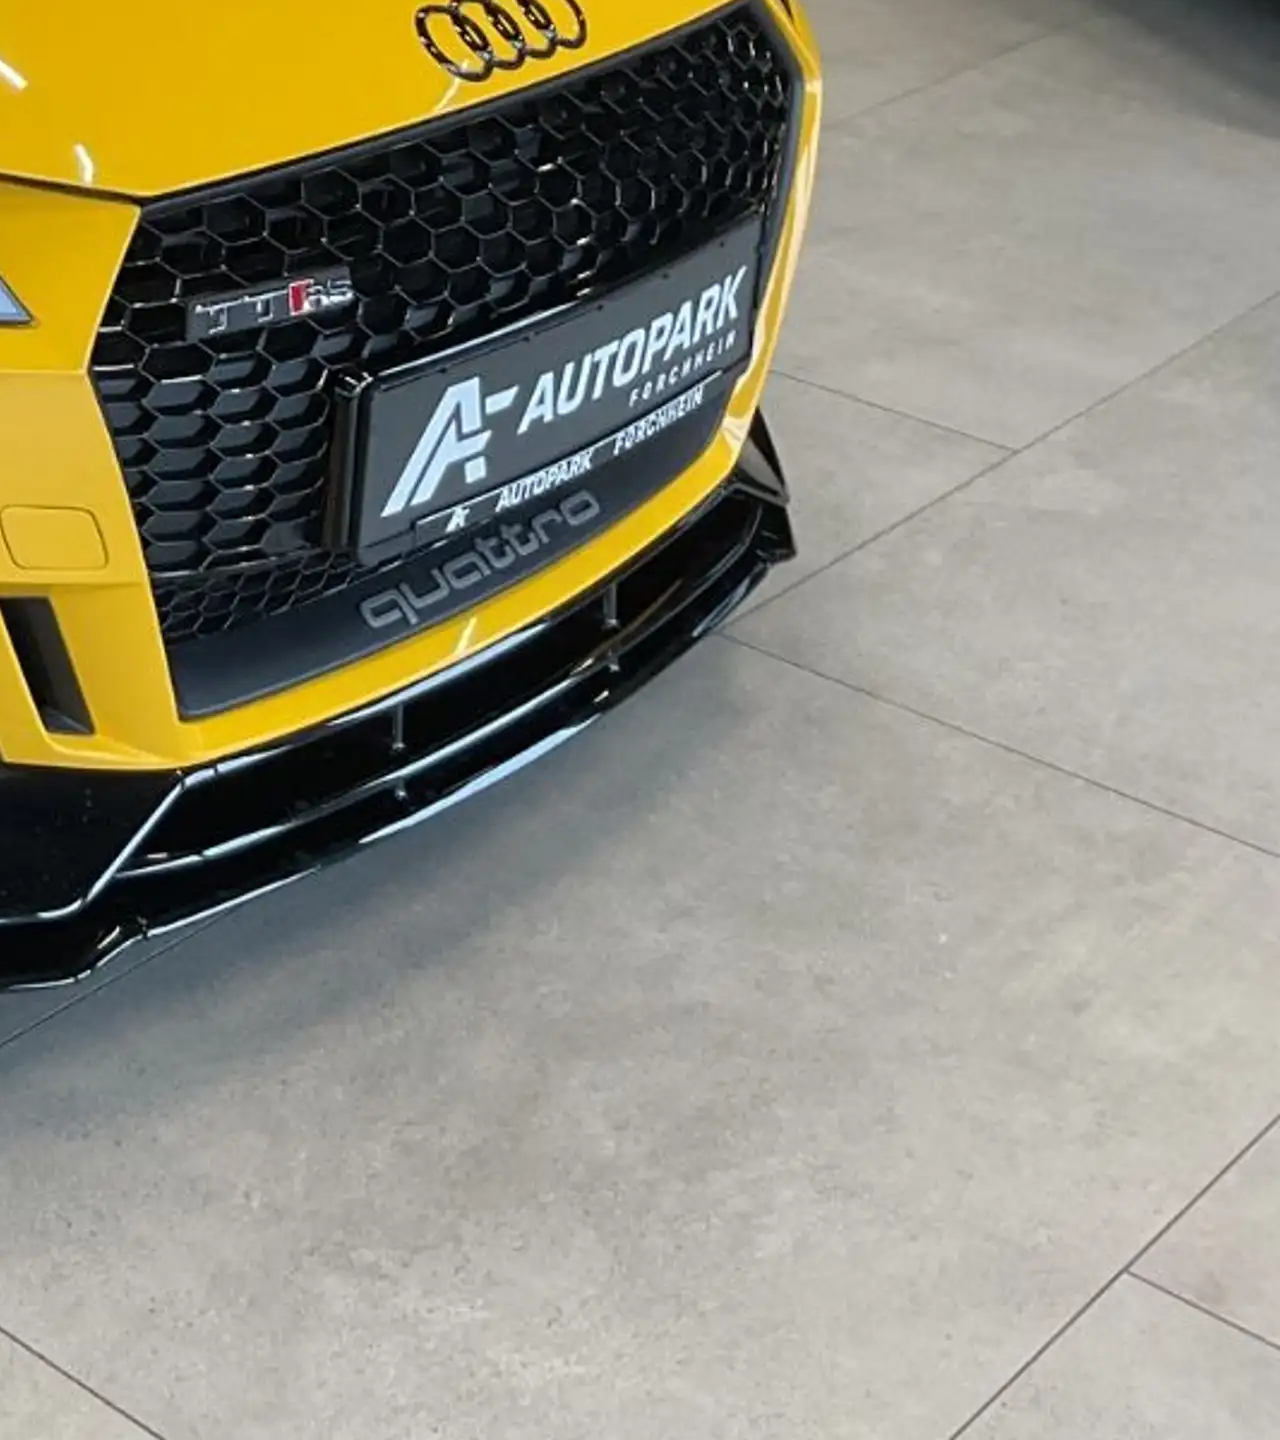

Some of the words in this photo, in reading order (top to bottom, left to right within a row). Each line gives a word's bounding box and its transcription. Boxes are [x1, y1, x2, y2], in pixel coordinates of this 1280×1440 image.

[517, 265, 748, 435] AUTOPARK
[495, 451, 594, 513] AUTOPARK
[360, 490, 600, 629] quattro
